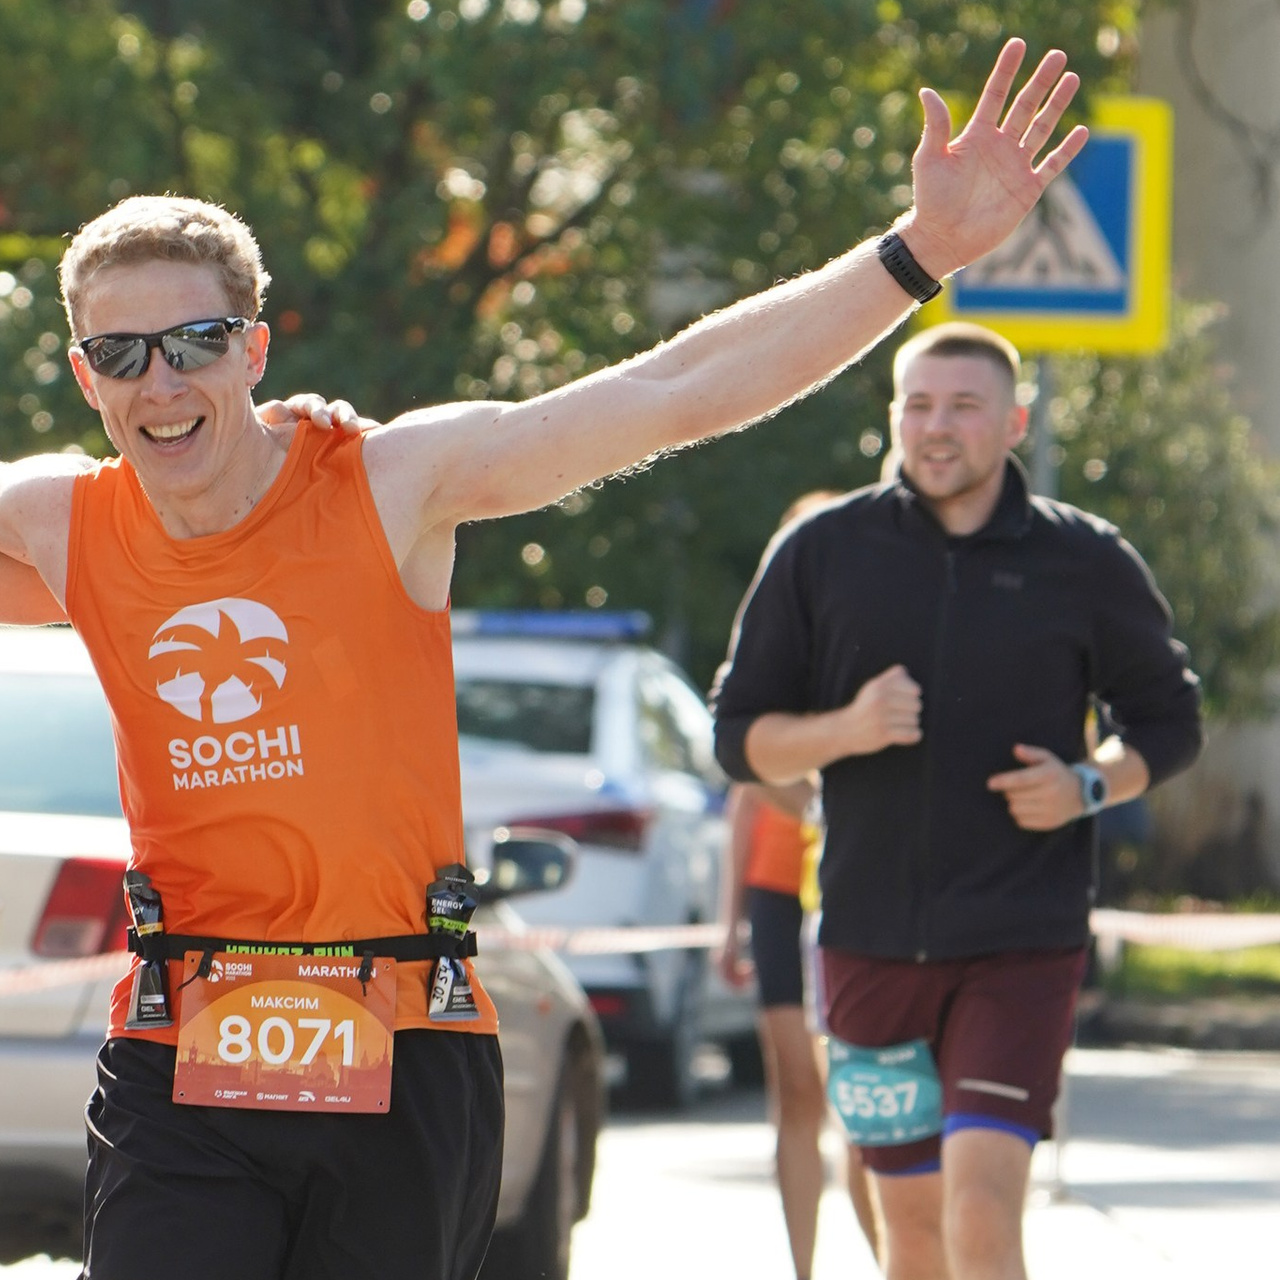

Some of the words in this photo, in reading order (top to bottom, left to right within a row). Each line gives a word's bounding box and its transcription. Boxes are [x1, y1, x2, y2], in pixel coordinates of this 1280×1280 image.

[168, 724, 302, 770] SOCHI
[172, 758, 305, 791] MARATHON
[431, 898, 464, 911] ENERGY
[225, 962, 252, 971] SOCHI
[298, 964, 377, 979] MARATHN
[251, 995, 319, 1010] МАКСИМ
[217, 1014, 355, 1067] 8071
